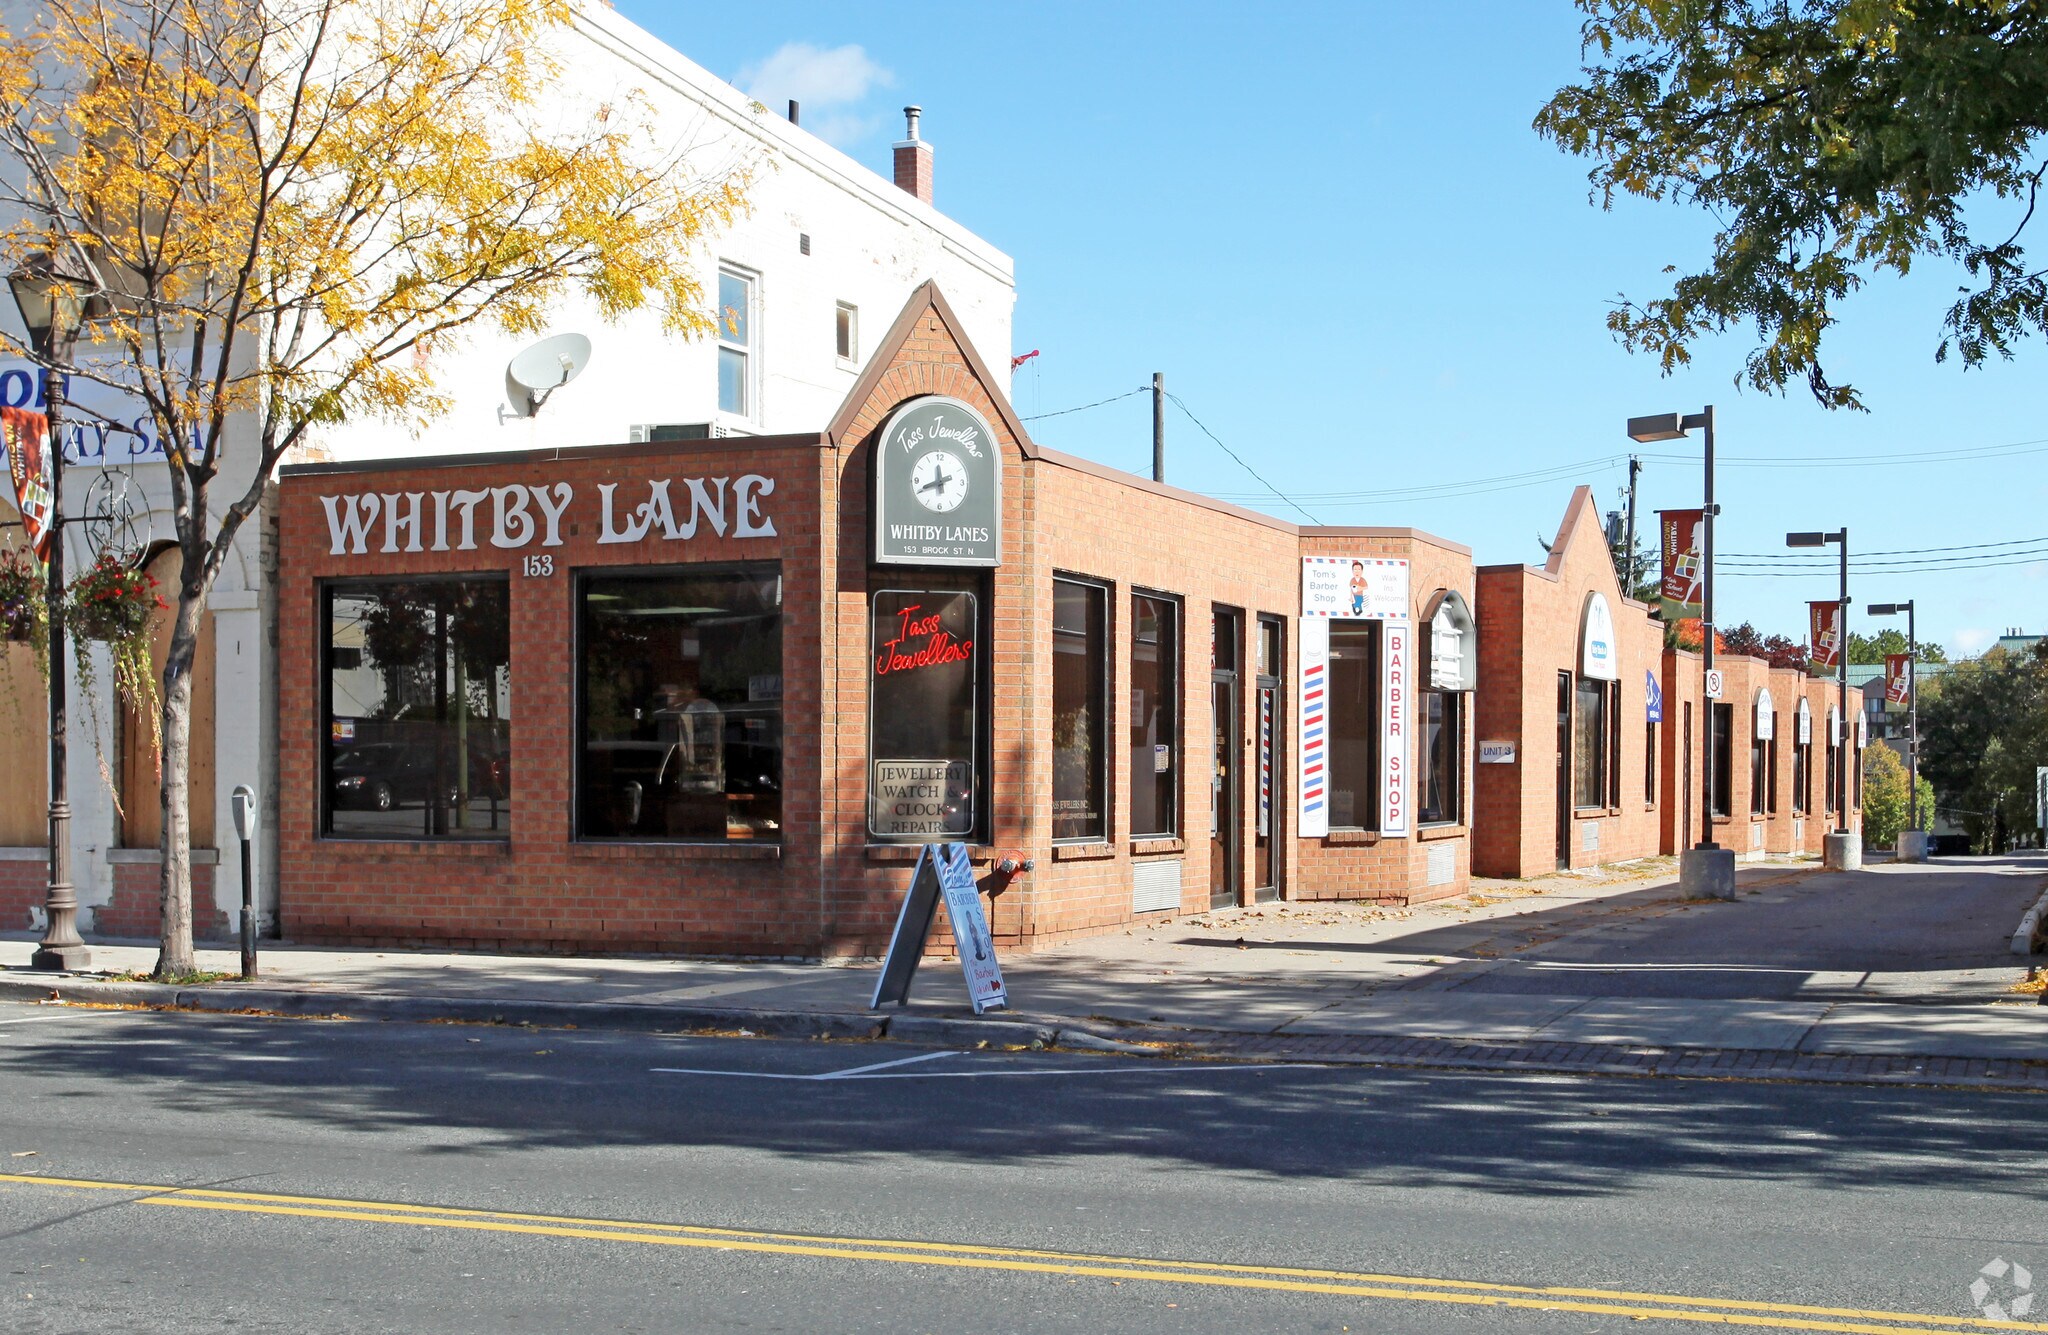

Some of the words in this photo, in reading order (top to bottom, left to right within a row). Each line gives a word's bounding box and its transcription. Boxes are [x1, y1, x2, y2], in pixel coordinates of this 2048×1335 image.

[897, 427, 924, 453] Tass
[929, 416, 983, 458] Jewellers
[319, 482, 573, 555] WHITBY
[597, 474, 777, 544] LANE
[891, 524, 943, 540] WHITBY
[945, 527, 989, 542] LANES
[922, 546, 949, 555] BROCK
[523, 554, 554, 577] 153
[1312, 569, 1336, 579] Tom's
[1309, 581, 1338, 590] Barber
[1314, 593, 1336, 603] Shop
[897, 605, 941, 642] Tass
[876, 633, 972, 675] Jewellers
[1390, 636, 1401, 736] BARBER
[1483, 746, 1503, 756] UNIT
[1504, 746, 1511, 755] 3
[880, 767, 963, 782] JEWELLERY
[883, 785, 939, 798] WATCH
[947, 786, 959, 798] &
[1389, 757, 1401, 822] SHOP
[895, 803, 946, 816] CLOCK
[891, 821, 951, 833] REPAIRS
[950, 892, 978, 907] BARBER
[976, 906, 993, 961] SHOP
